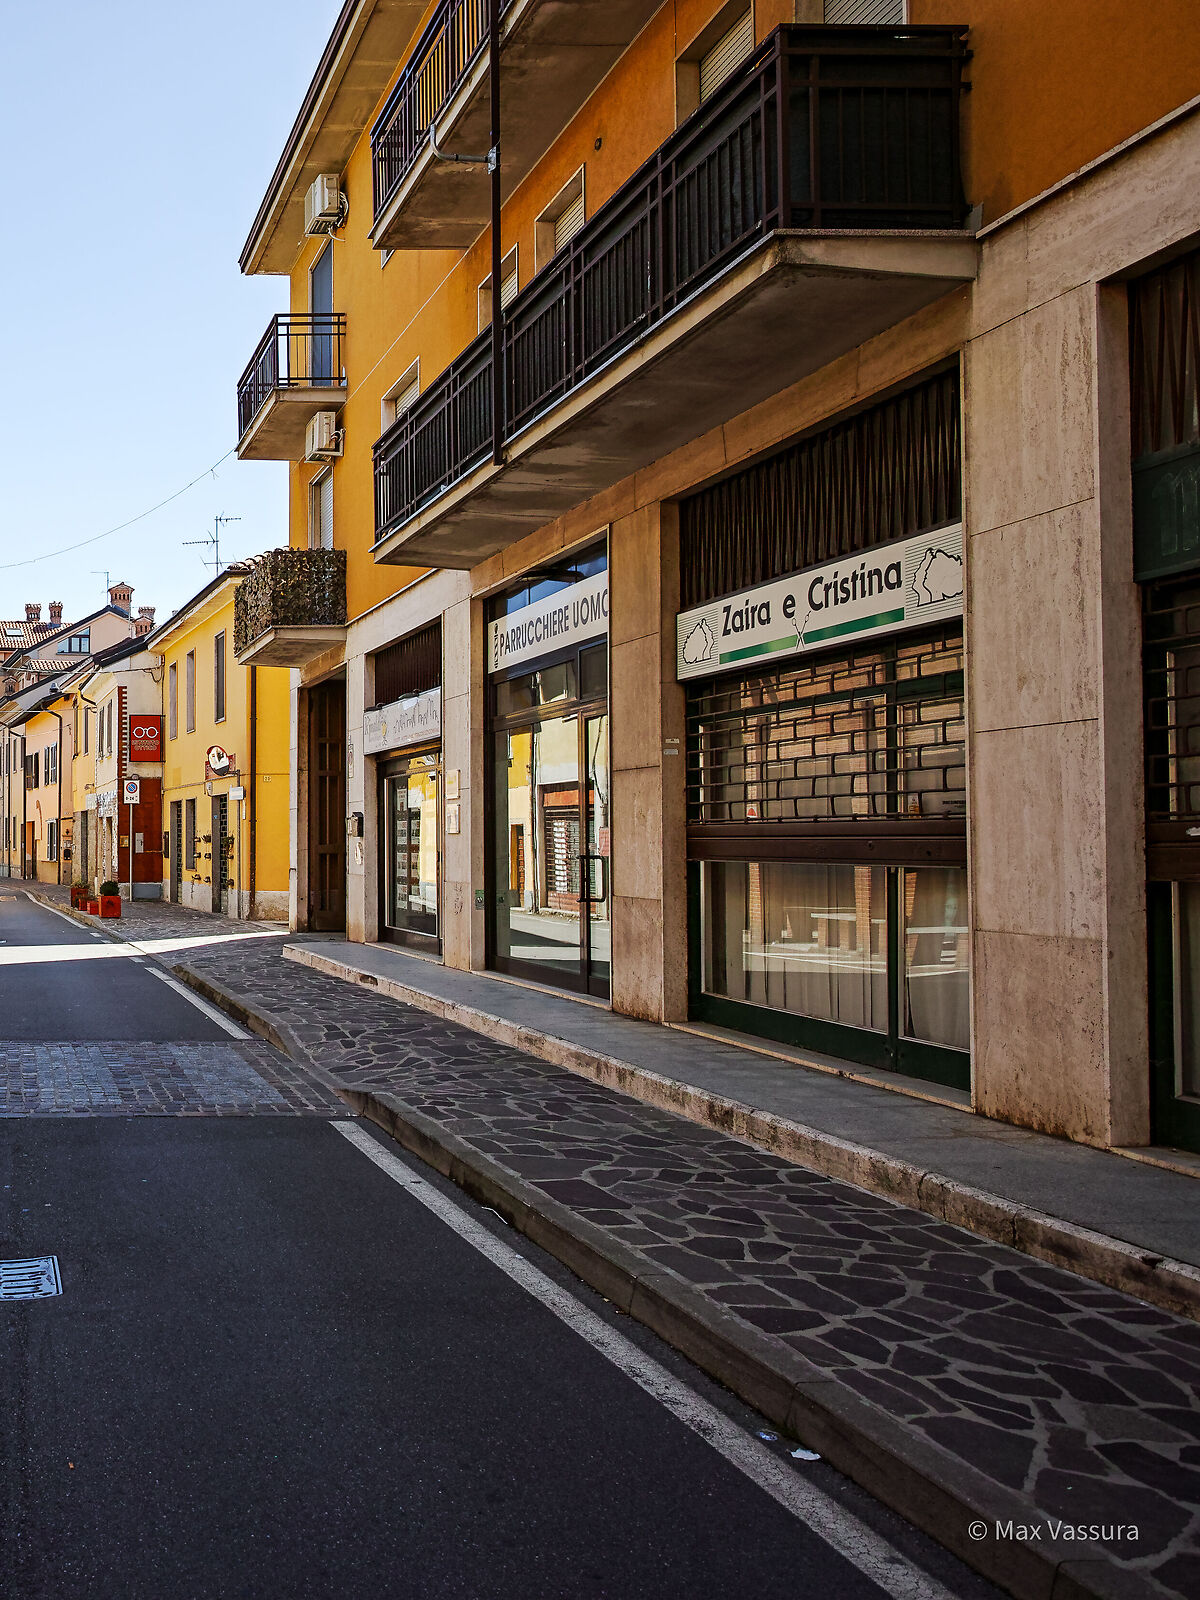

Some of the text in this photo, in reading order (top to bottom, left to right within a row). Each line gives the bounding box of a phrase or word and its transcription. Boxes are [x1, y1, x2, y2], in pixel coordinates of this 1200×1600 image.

[722, 560, 903, 636] Zaira e Cristina
[500, 605, 569, 656] PARRUCCHIERE
